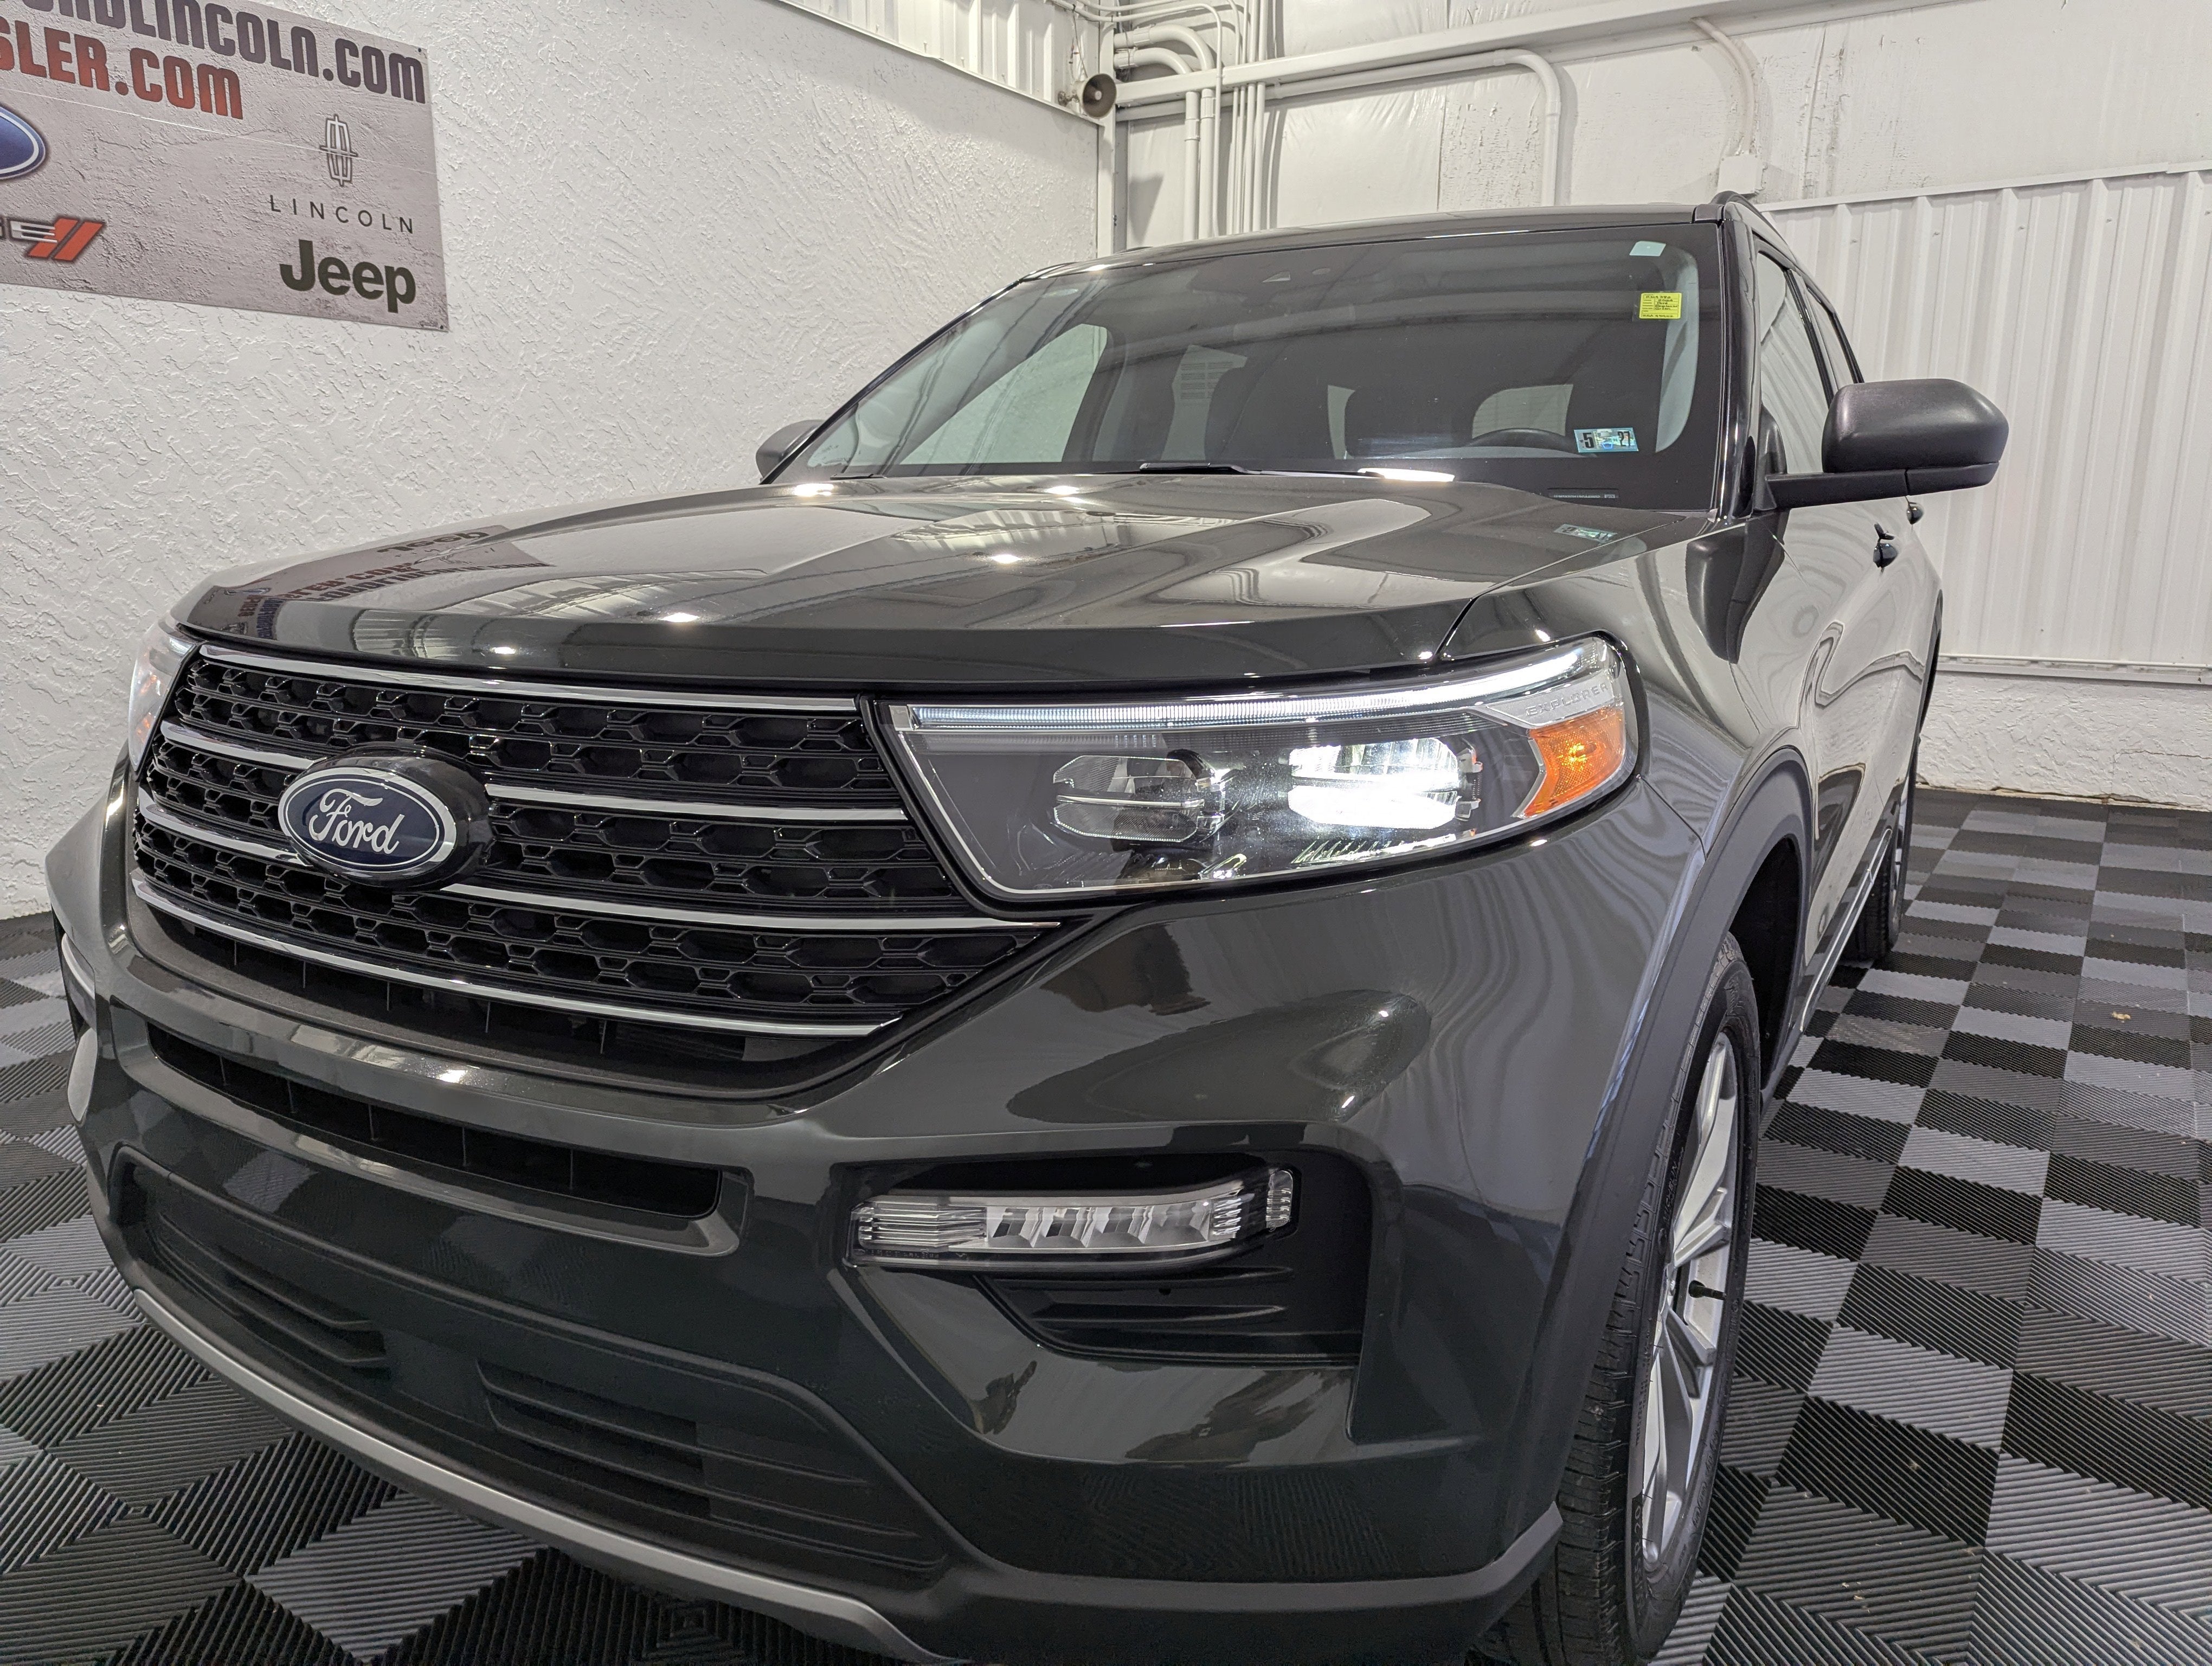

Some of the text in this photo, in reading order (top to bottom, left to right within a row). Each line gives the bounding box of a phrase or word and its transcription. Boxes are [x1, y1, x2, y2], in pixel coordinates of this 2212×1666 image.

[0, 0, 426, 104] DLINCOLN.COM
[270, 195, 414, 234] LINCOLN
[280, 239, 416, 312] Jeep
[1583, 432, 1594, 448] 5
[1526, 682, 1609, 717] EXPLORER
[308, 788, 405, 854] Ford
